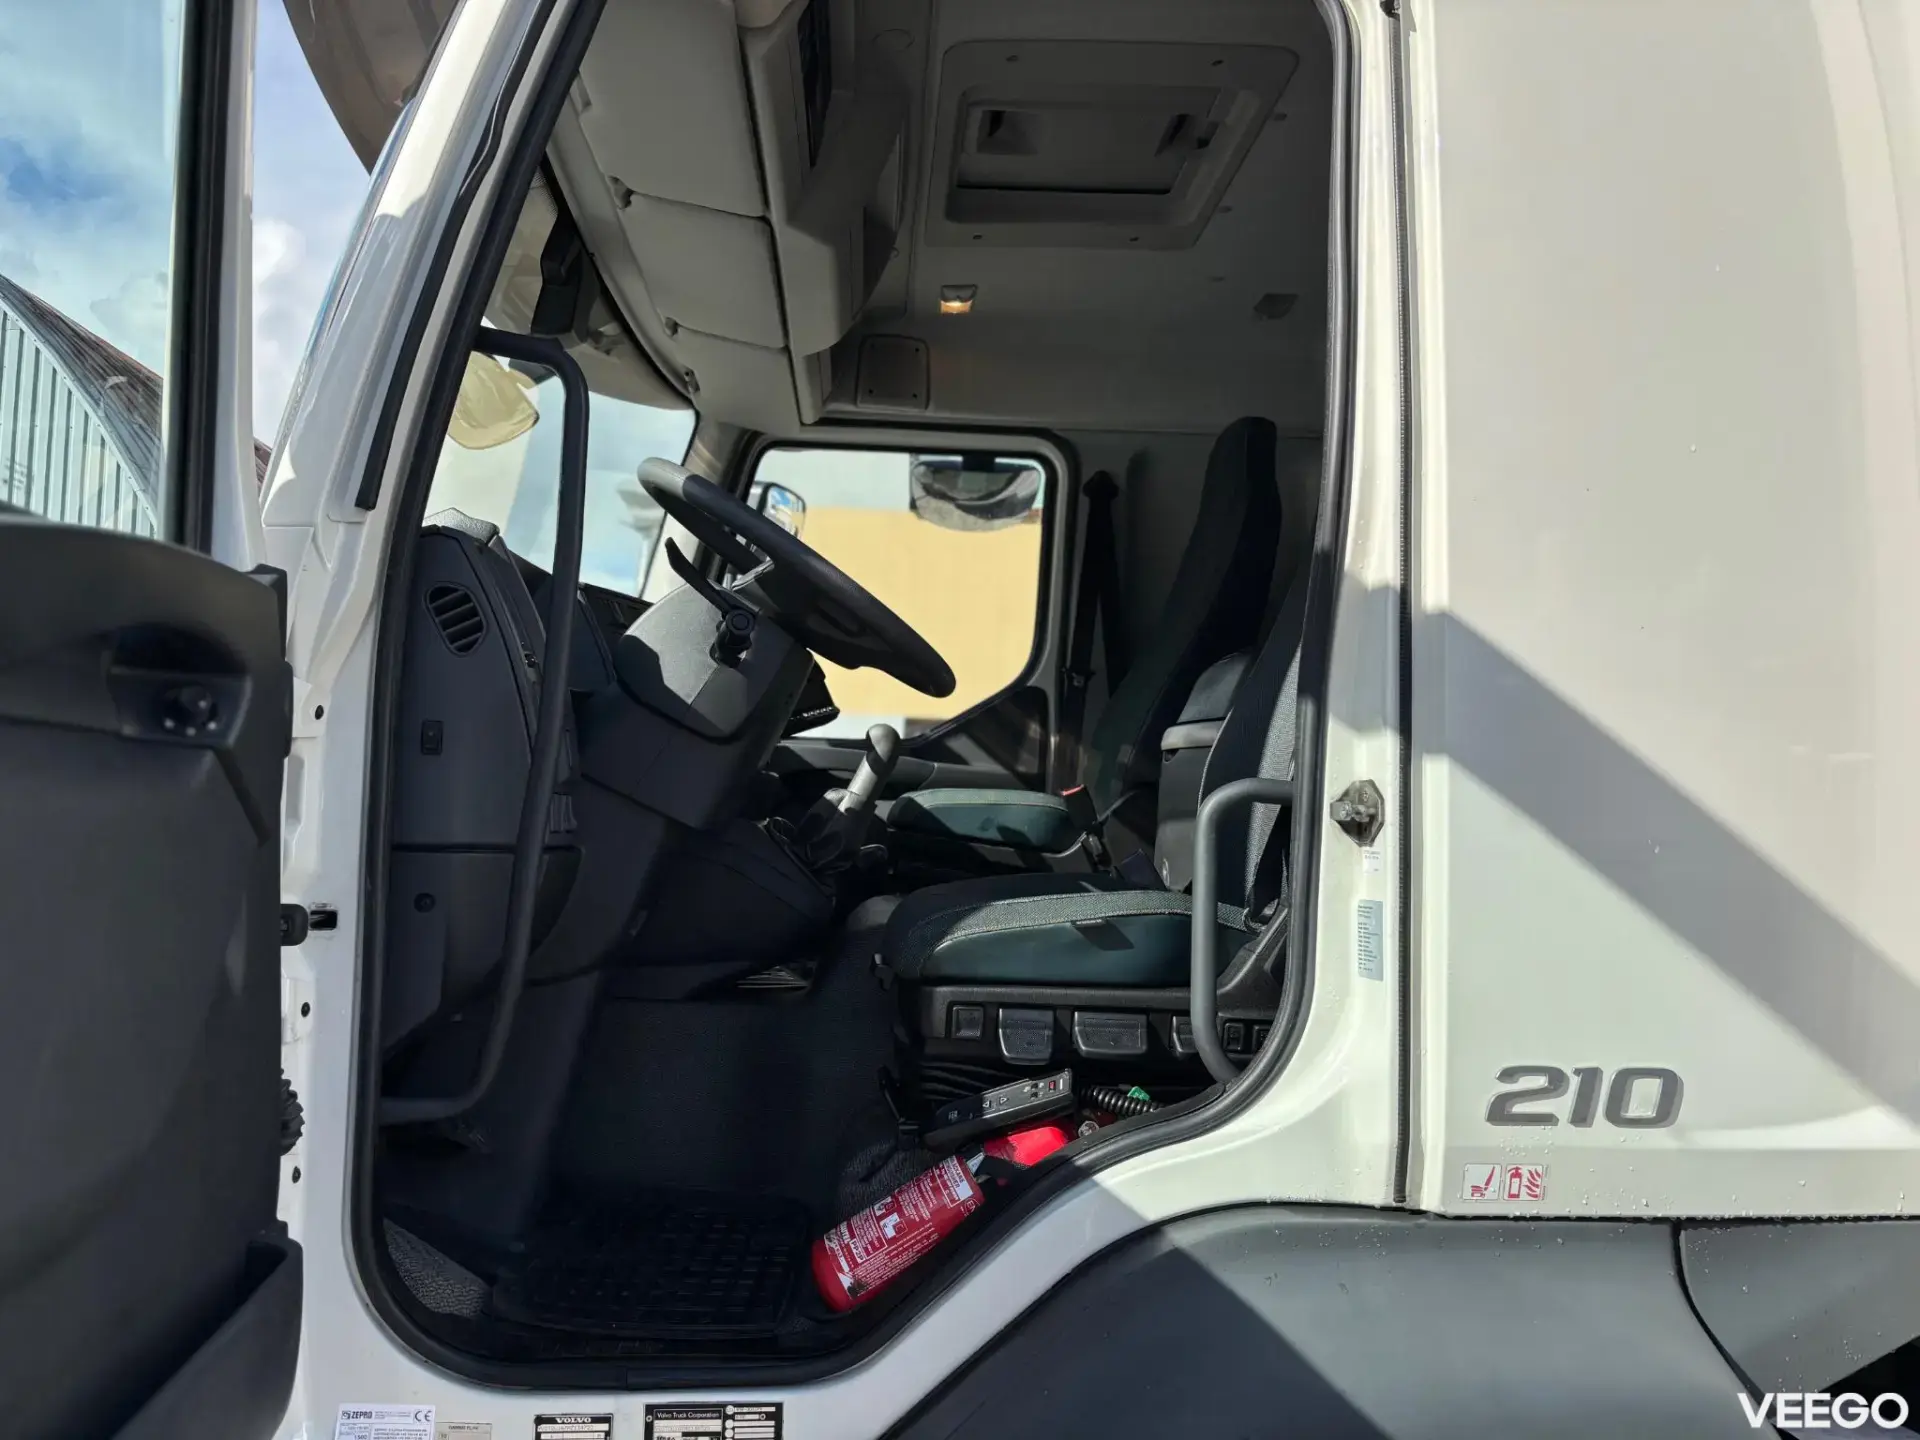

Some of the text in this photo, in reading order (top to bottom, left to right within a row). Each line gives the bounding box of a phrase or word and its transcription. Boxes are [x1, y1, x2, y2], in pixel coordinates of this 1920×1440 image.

[1485, 1065, 1685, 1128] 210
[851, 1240, 865, 1261] PP2P
[351, 1411, 373, 1419] ZEPRO
